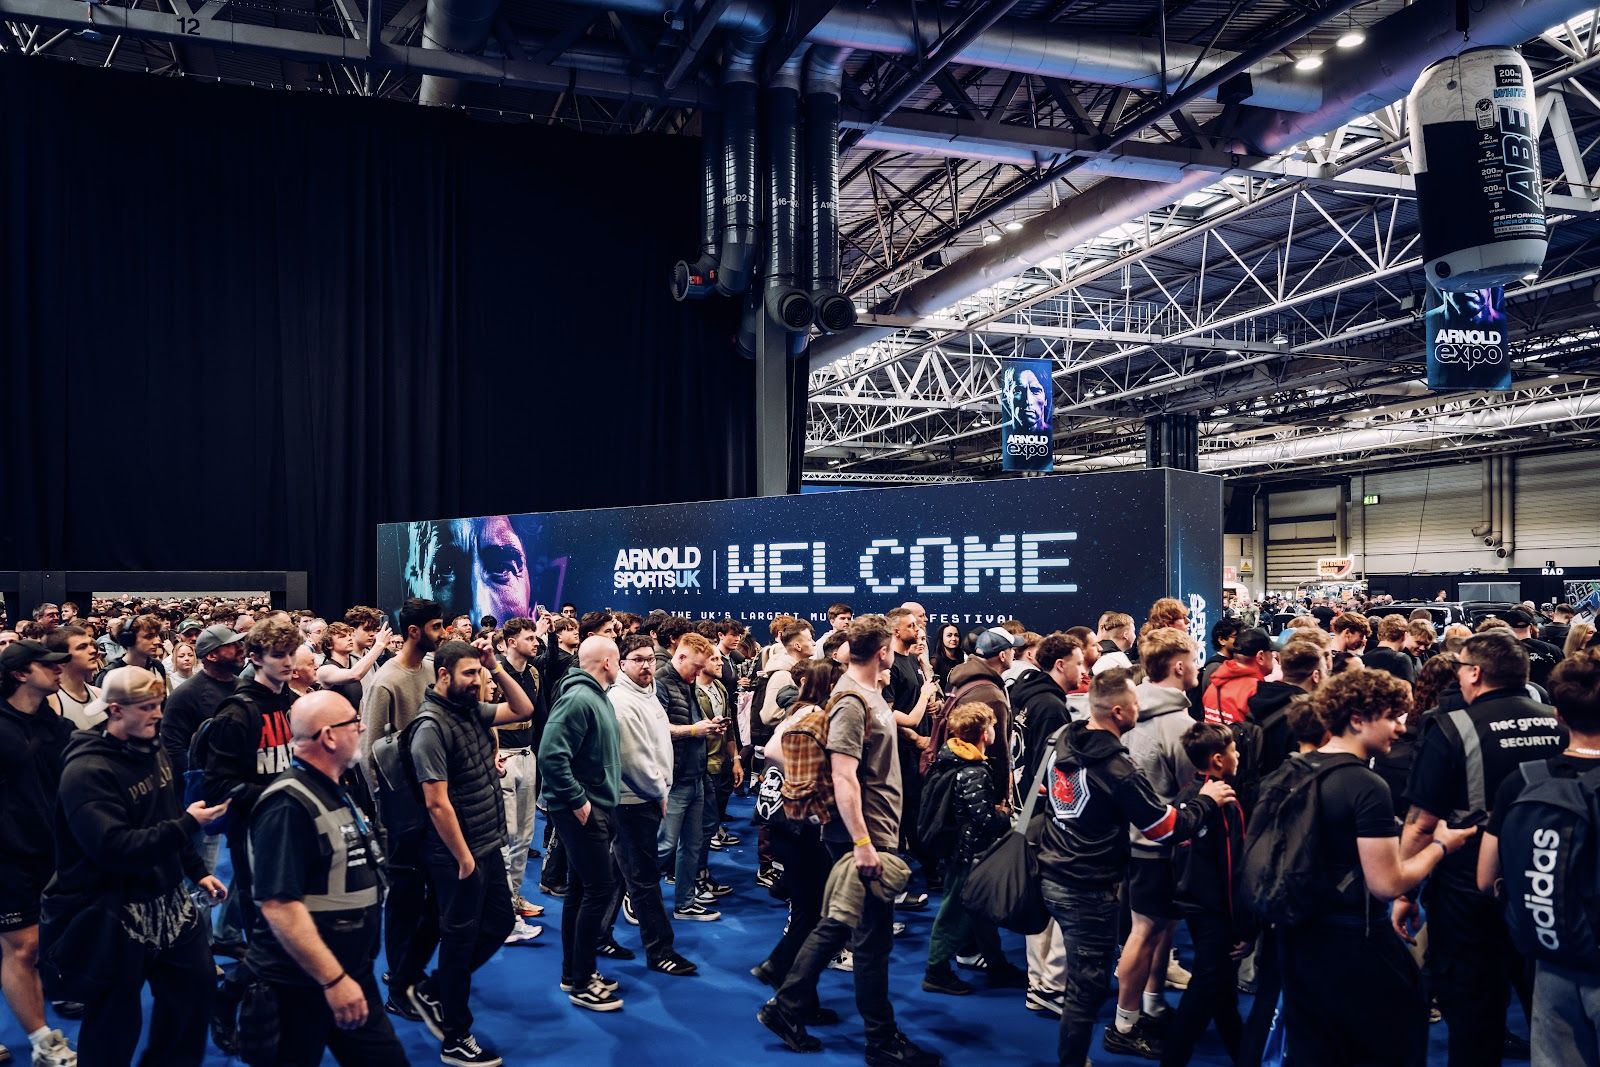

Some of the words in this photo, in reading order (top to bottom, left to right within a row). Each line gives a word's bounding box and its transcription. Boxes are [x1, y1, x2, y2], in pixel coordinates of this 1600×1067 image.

[176, 16, 201, 36] 12
[1493, 87, 1527, 98] WHITE
[1496, 104, 1541, 209] ABE
[1434, 328, 1502, 345] ARNOLD
[1434, 343, 1503, 371] expo
[1006, 434, 1049, 444] ARNOLD
[1006, 443, 1049, 461] expo
[613, 546, 702, 571] ARNOLD
[727, 531, 1078, 594] WELCOME
[613, 569, 701, 589] SPORTSUK
[1541, 567, 1565, 576] RAD
[671, 611, 692, 619] THE
[700, 611, 731, 620] UK'S
[1196, 593, 1207, 670] ARNO
[1489, 719, 1517, 732] nec
[1517, 717, 1559, 732] group
[1499, 735, 1560, 749] SECURITY
[1524, 828, 1560, 950] adidas
